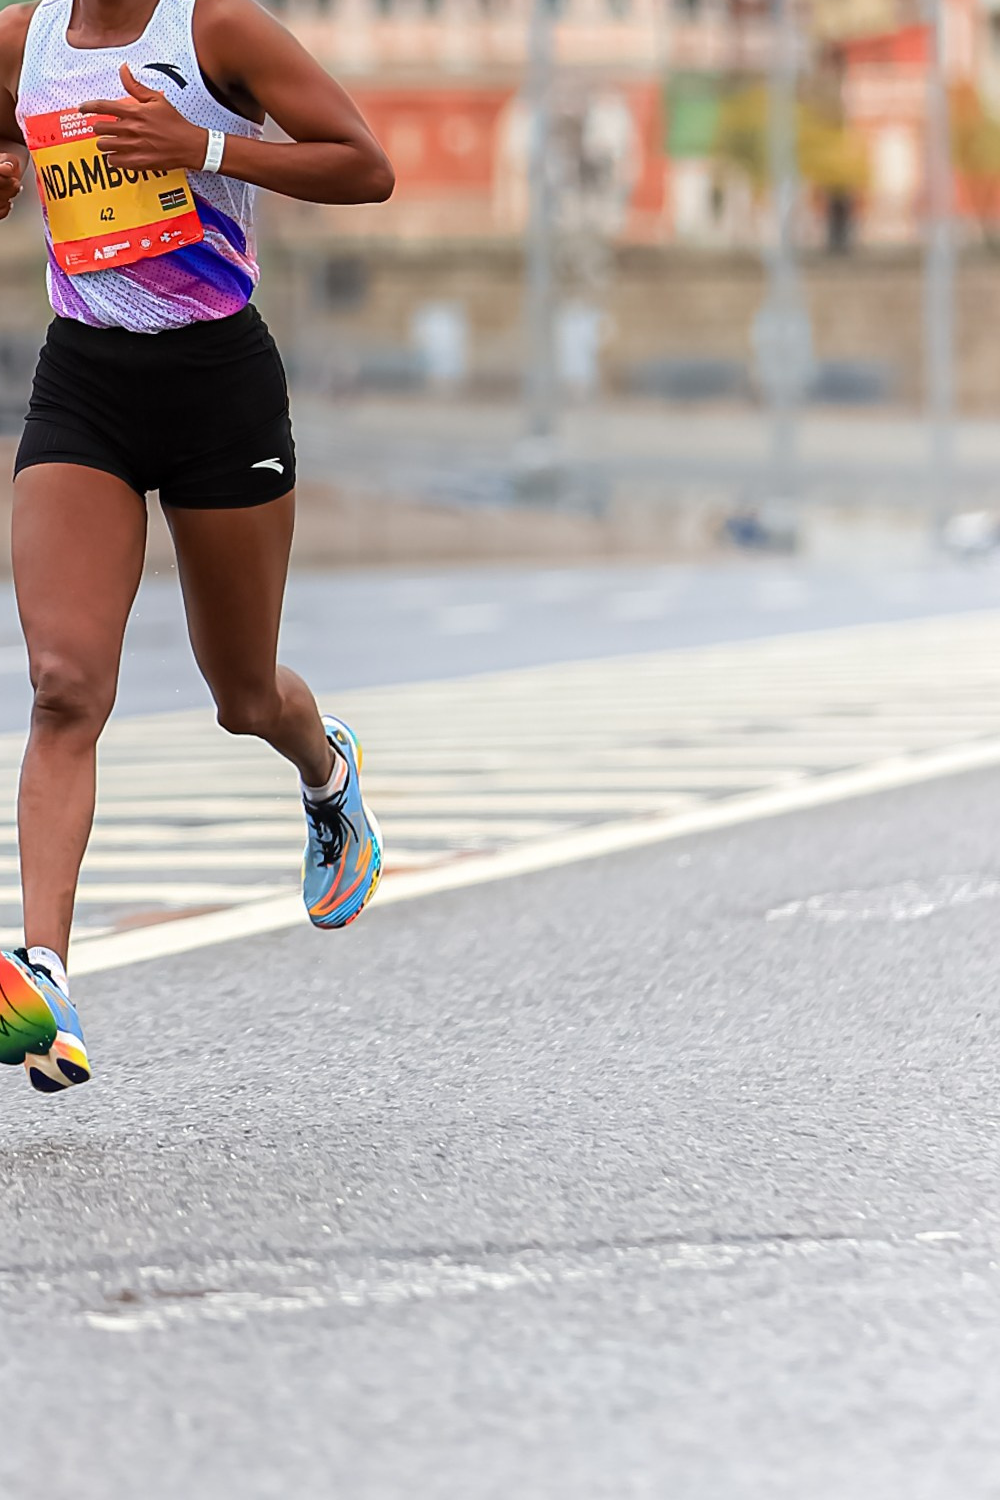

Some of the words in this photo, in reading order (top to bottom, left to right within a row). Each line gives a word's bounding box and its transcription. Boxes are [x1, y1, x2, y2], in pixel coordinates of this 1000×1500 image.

[60, 119, 81, 131] ПОЛУ
[62, 126, 94, 138] МАРАФО
[100, 207, 115, 221] 42
